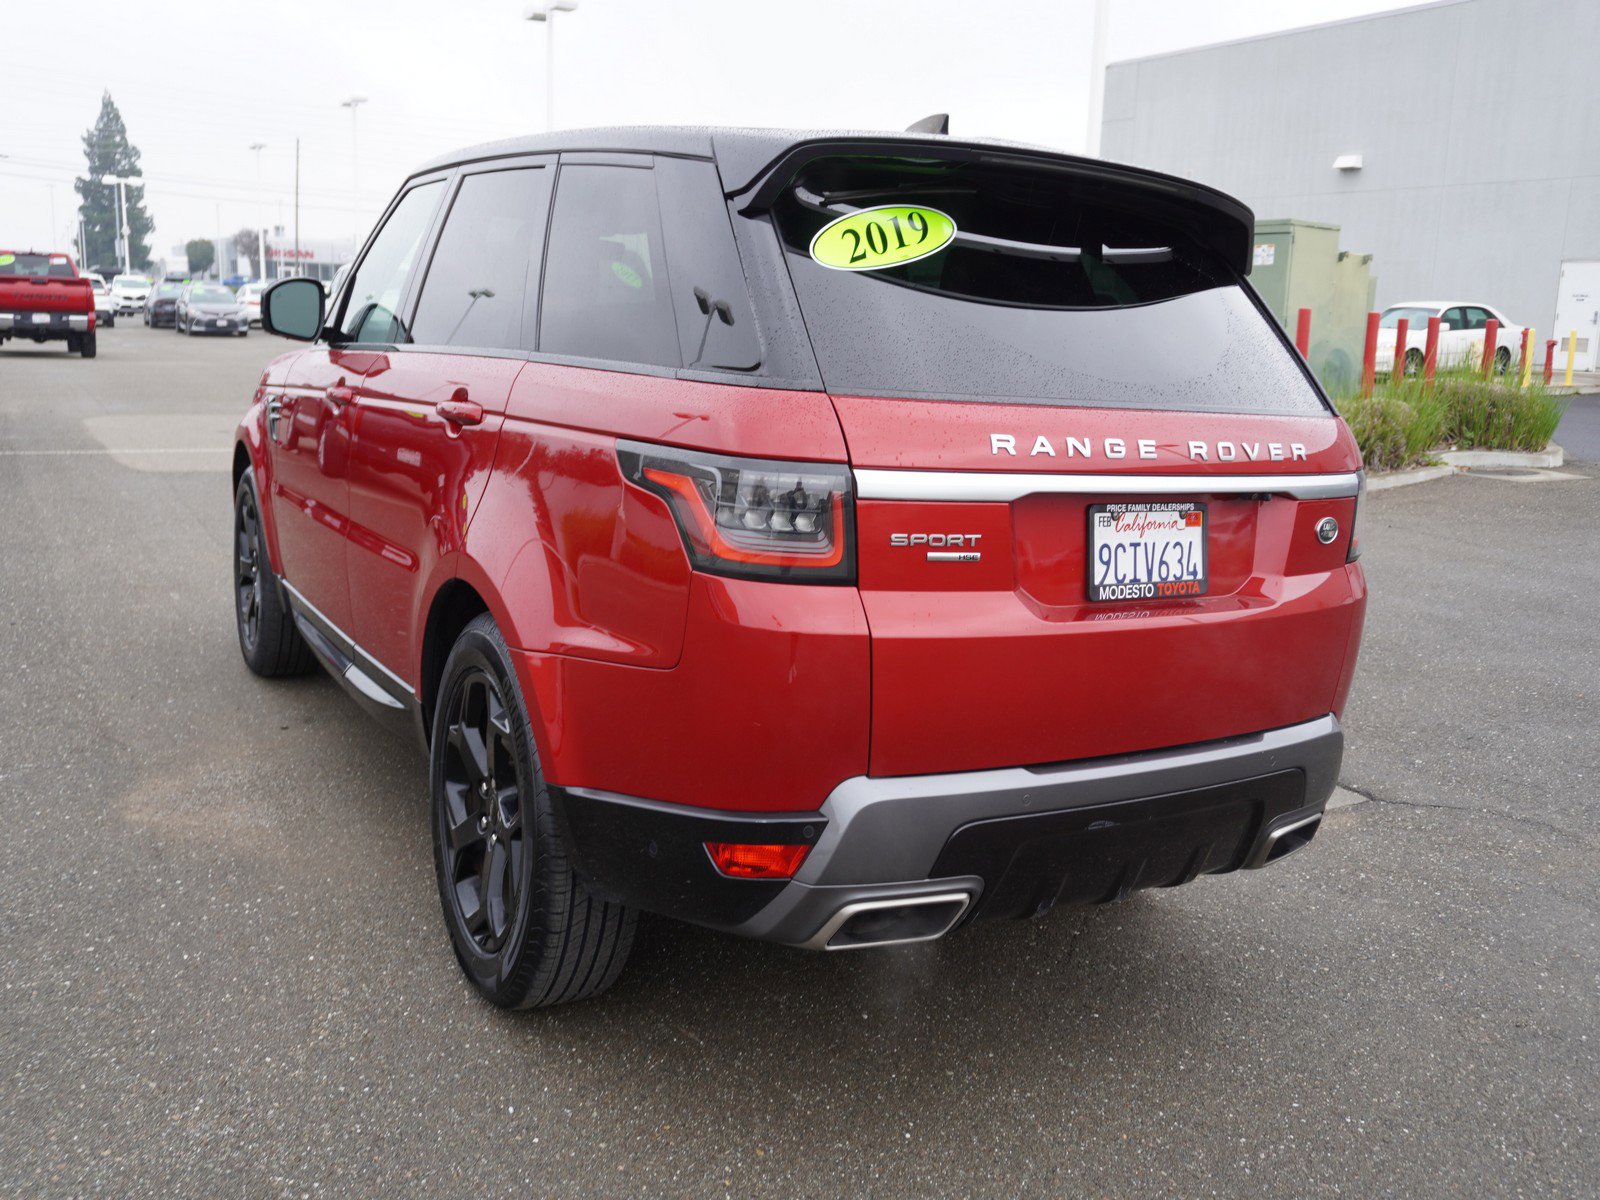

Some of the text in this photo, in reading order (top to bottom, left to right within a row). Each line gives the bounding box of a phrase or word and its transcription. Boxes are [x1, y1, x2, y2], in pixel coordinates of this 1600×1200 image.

[841, 211, 929, 264] 2019
[989, 433, 1307, 462] RANGE ROVER
[1106, 502, 1195, 512] PRICE FAMILY DEALERSHIPS
[1098, 516, 1112, 528] FEB
[1115, 511, 1185, 539] California
[890, 533, 982, 547] SPORT
[1098, 541, 1198, 585] 9CIV634
[1099, 581, 1200, 600] MODESTO TOYOTA
